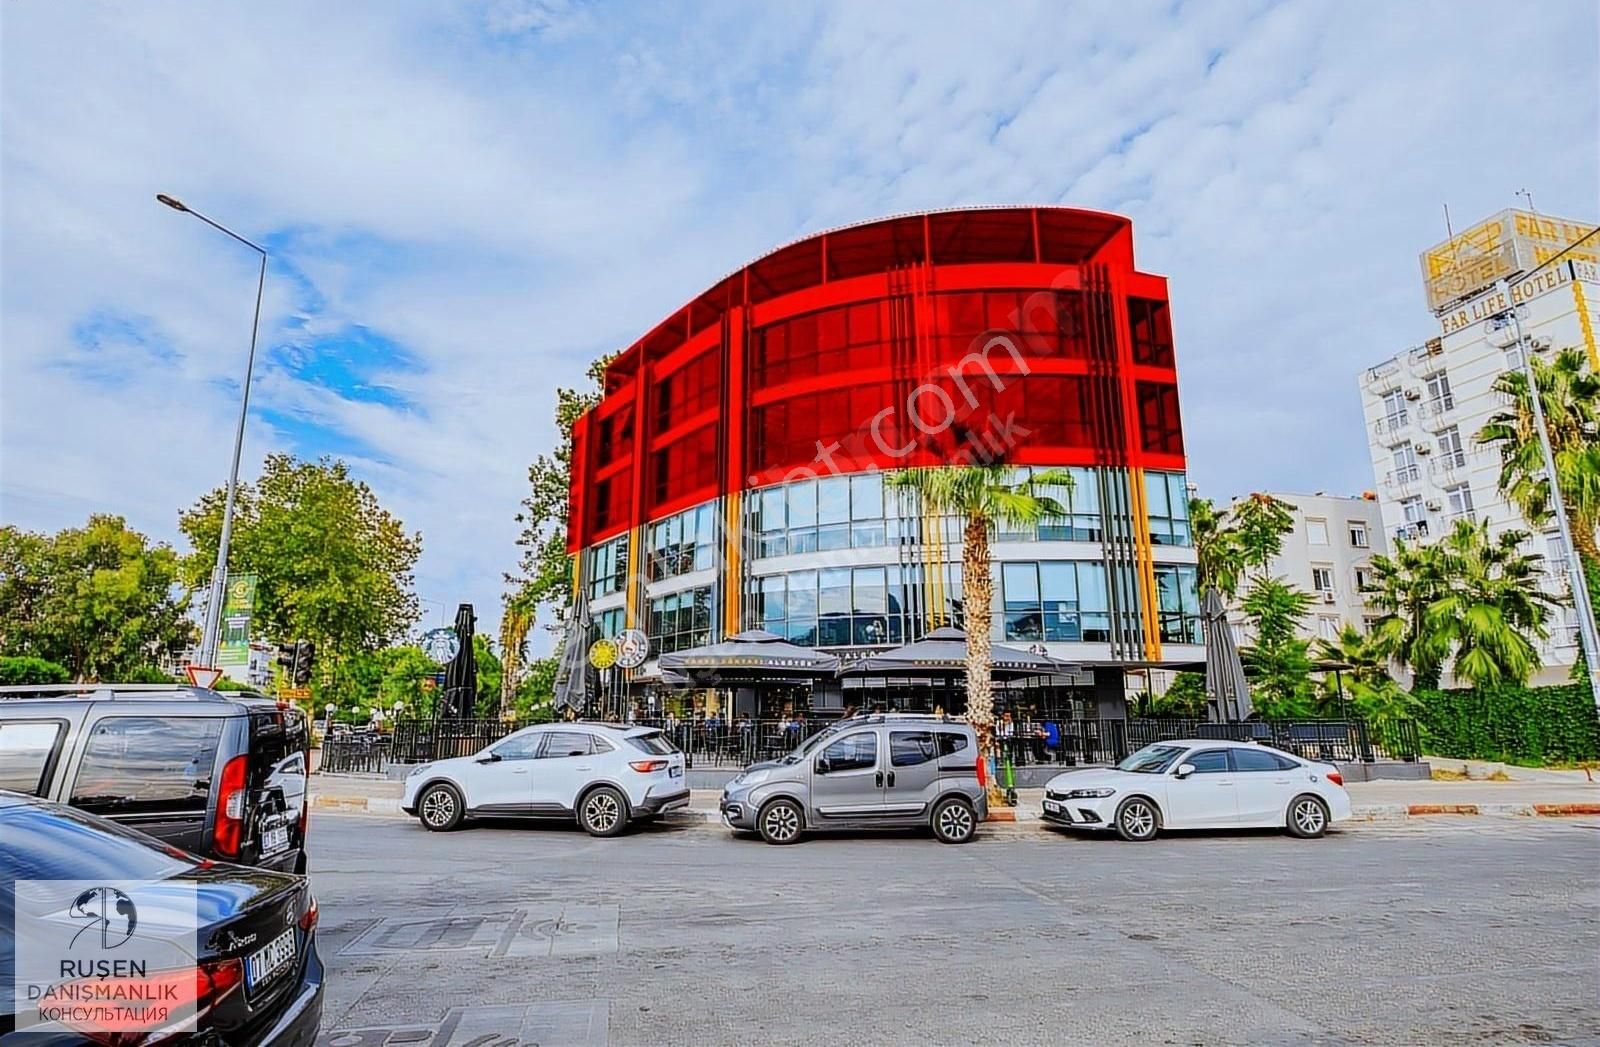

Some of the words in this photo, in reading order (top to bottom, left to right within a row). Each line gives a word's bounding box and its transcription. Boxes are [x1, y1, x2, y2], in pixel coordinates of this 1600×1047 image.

[1440, 310, 1470, 334] FAR
[1471, 292, 1508, 320] LIFE
[1511, 267, 1568, 303] HOTEL
